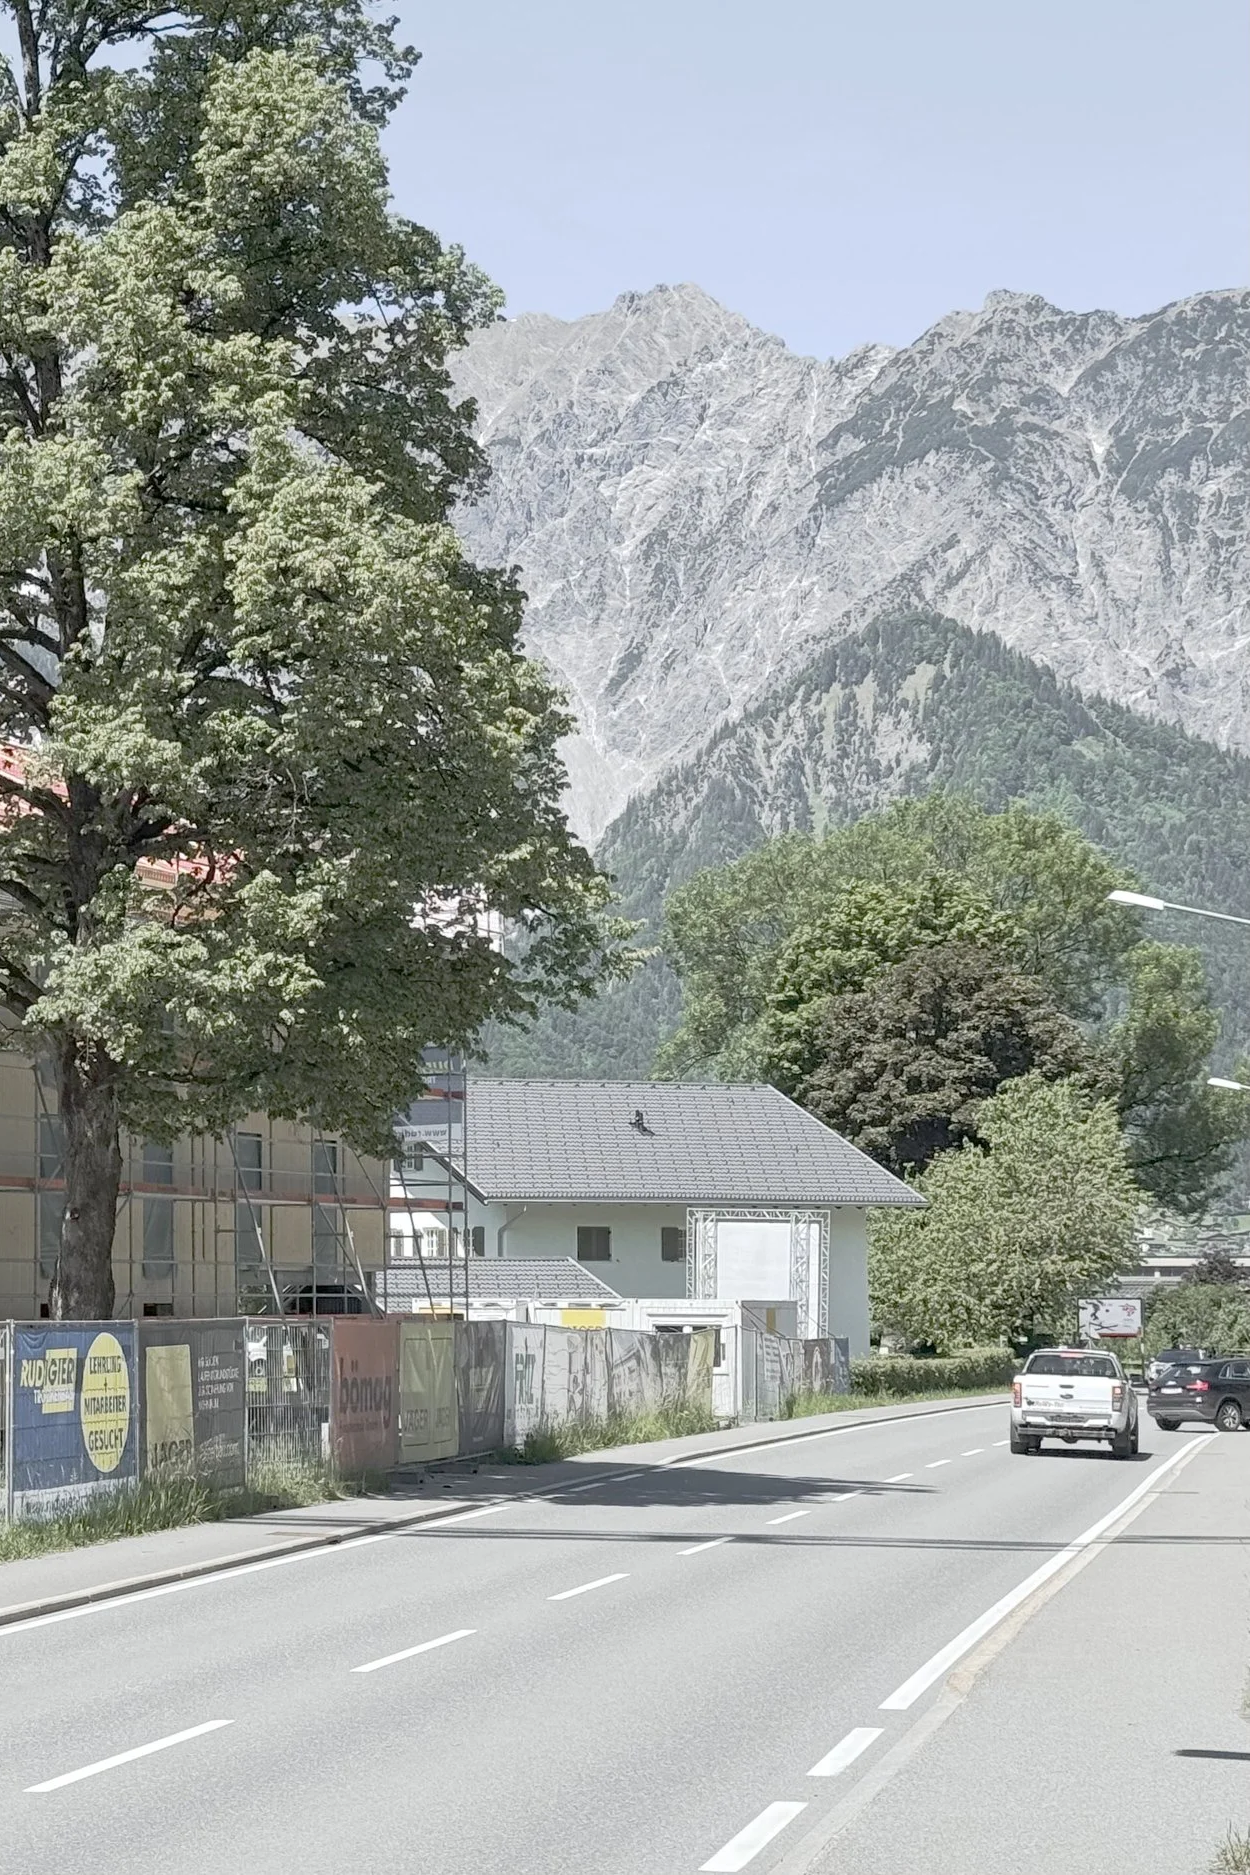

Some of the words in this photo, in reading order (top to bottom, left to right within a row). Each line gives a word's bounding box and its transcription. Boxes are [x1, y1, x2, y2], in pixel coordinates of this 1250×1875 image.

[89, 1355, 122, 1375] LEHRLING
[84, 1395, 127, 1415] MITARBEITER
[88, 1428, 124, 1451] GESUCHT
